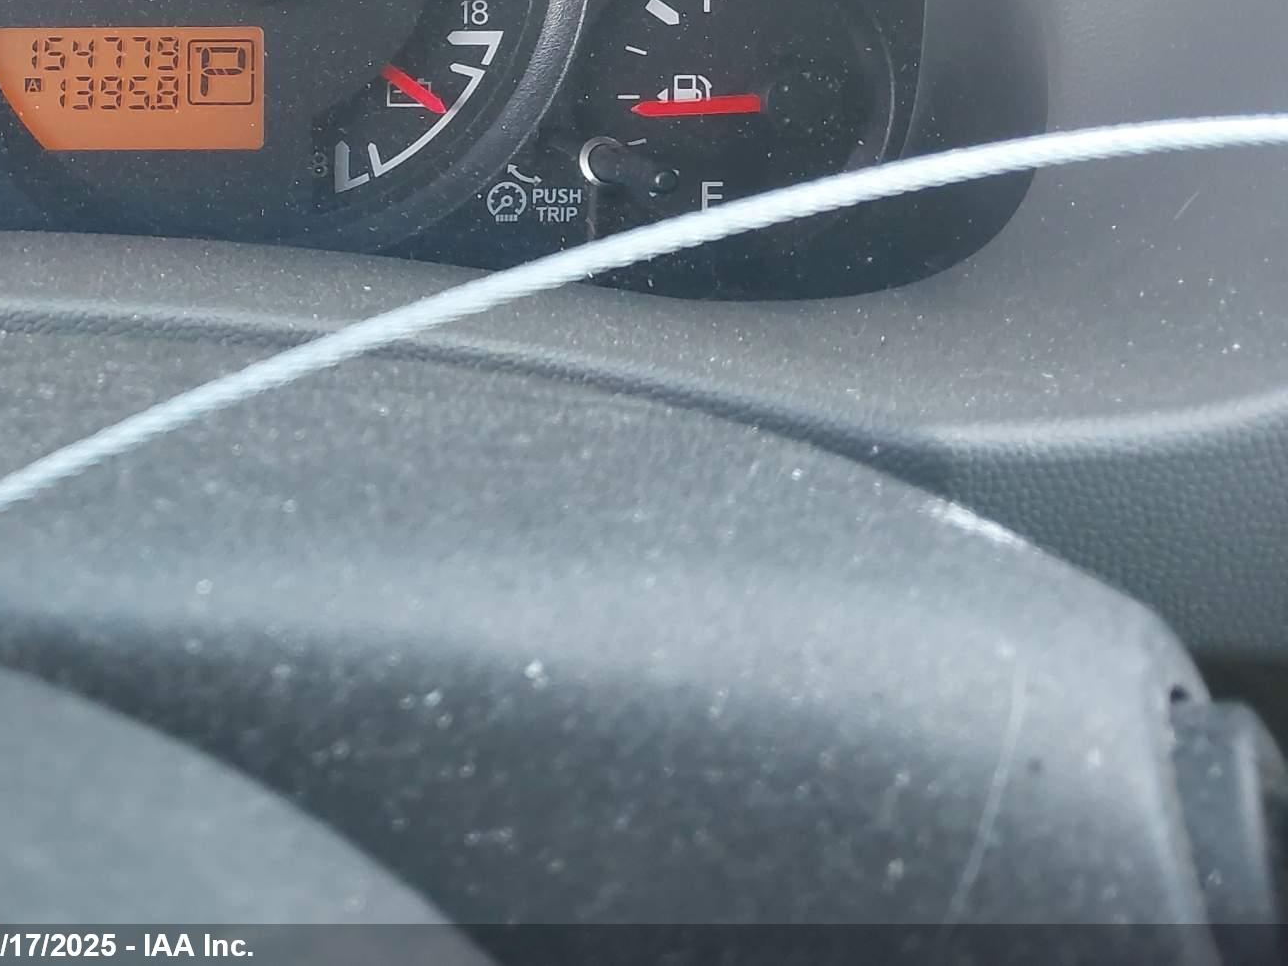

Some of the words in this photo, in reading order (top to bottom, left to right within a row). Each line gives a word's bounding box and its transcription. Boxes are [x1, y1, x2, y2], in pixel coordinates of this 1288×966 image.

[460, 0, 489, 25] 18
[31, 36, 180, 72] 154779
[195, 46, 247, 98] P
[58, 75, 180, 111] 1395.8
[532, 188, 582, 204] PUSH
[535, 205, 578, 223] TRIP
